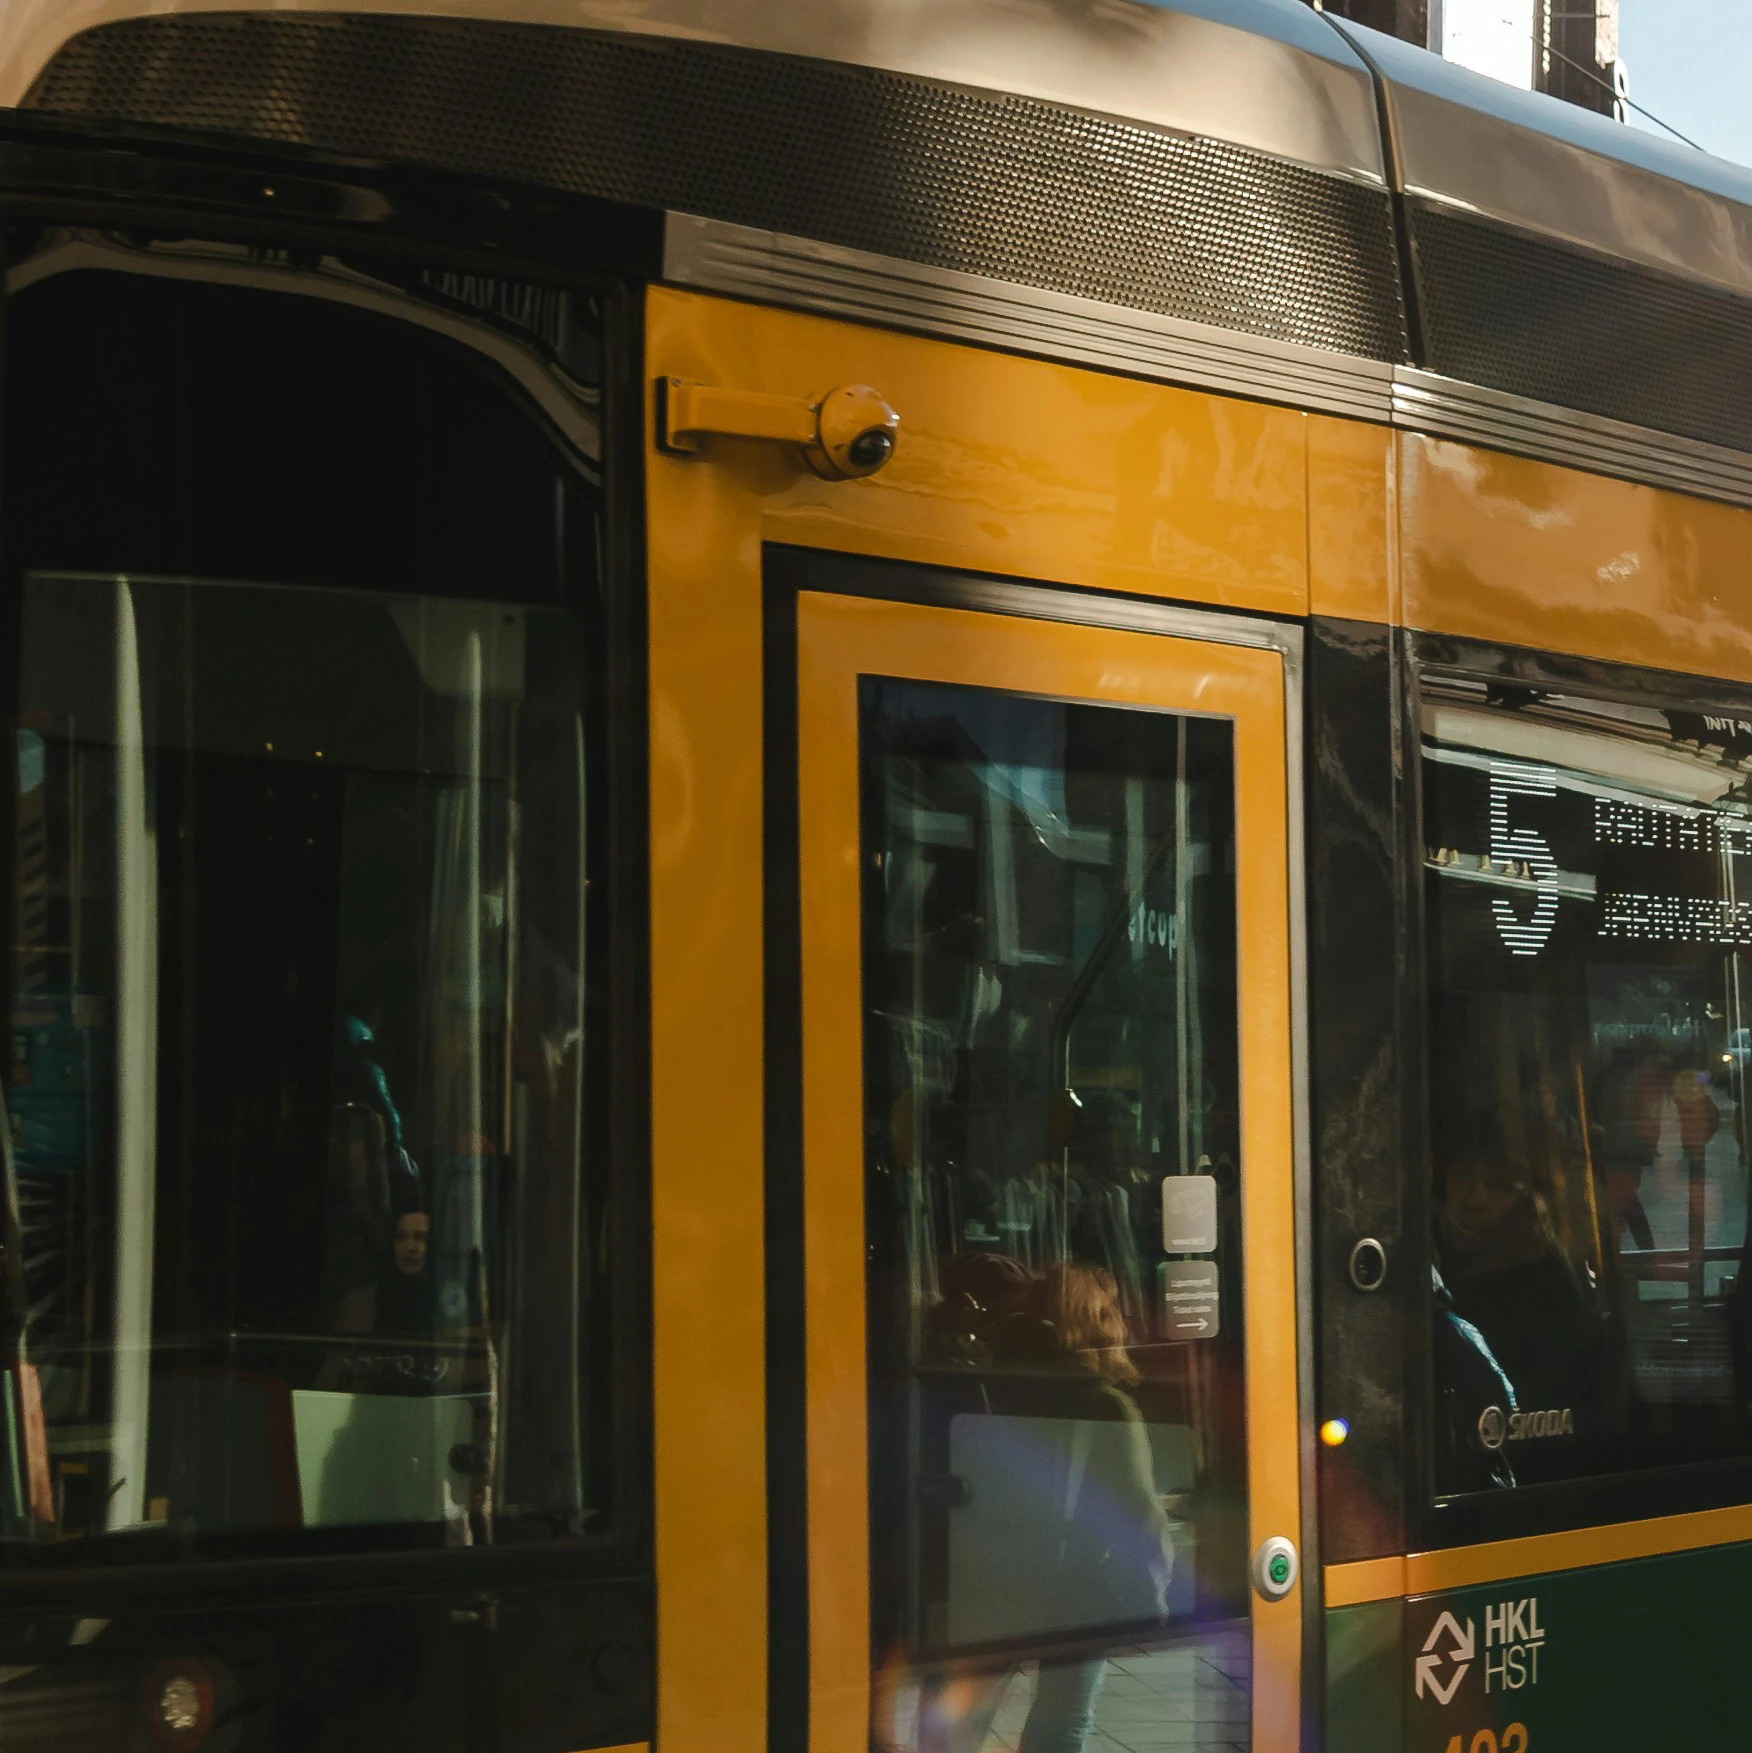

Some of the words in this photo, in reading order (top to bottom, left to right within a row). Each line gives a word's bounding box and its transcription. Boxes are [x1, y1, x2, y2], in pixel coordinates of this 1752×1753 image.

[1490, 761, 1560, 956] 5
[1485, 1597, 1546, 1648] HKL
[1485, 1641, 1546, 1694] HST
